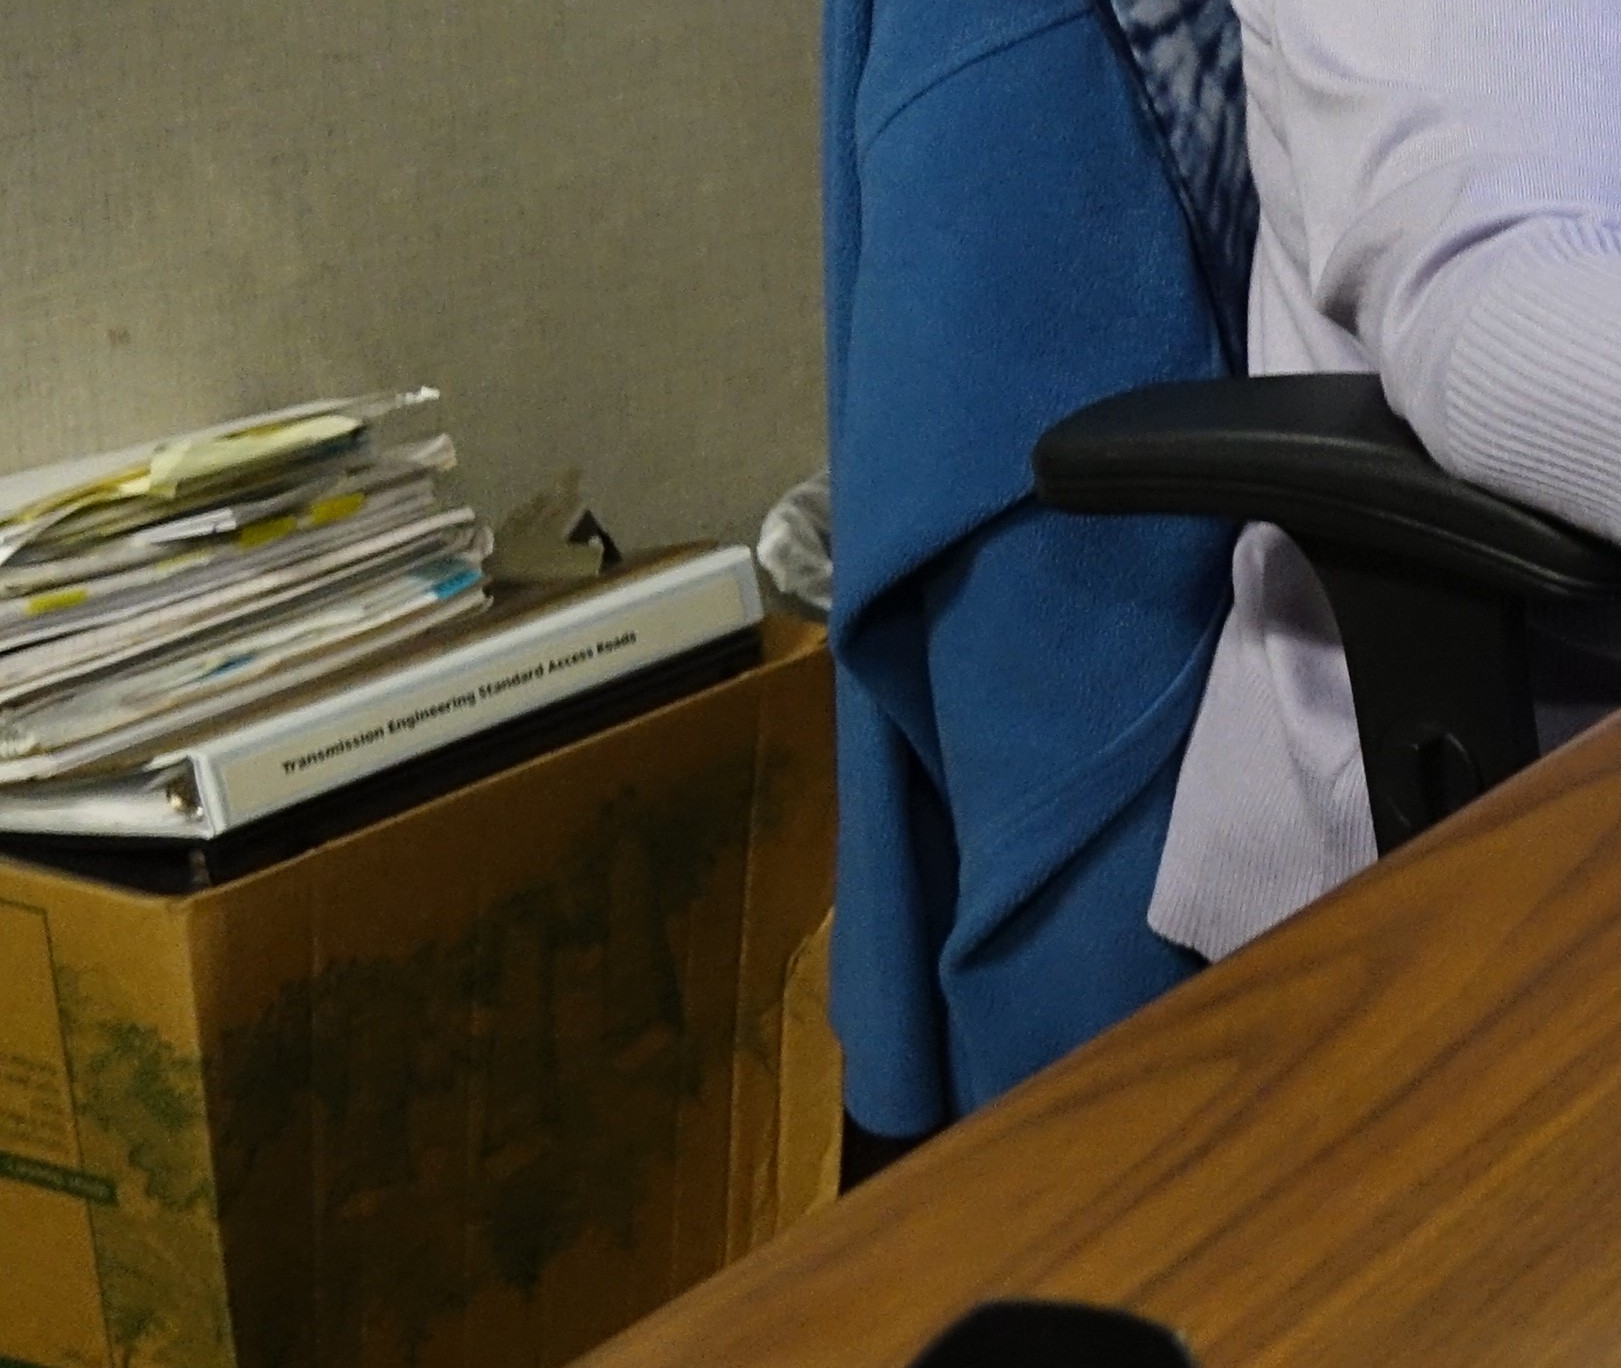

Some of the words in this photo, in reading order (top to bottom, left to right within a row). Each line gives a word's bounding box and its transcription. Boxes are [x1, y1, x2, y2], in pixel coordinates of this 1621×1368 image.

[282, 726, 385, 775] Transmission
[386, 691, 476, 735] Engineering
[477, 661, 544, 700] Standard
[548, 646, 594, 675] Access
[596, 629, 637, 655] Roads
